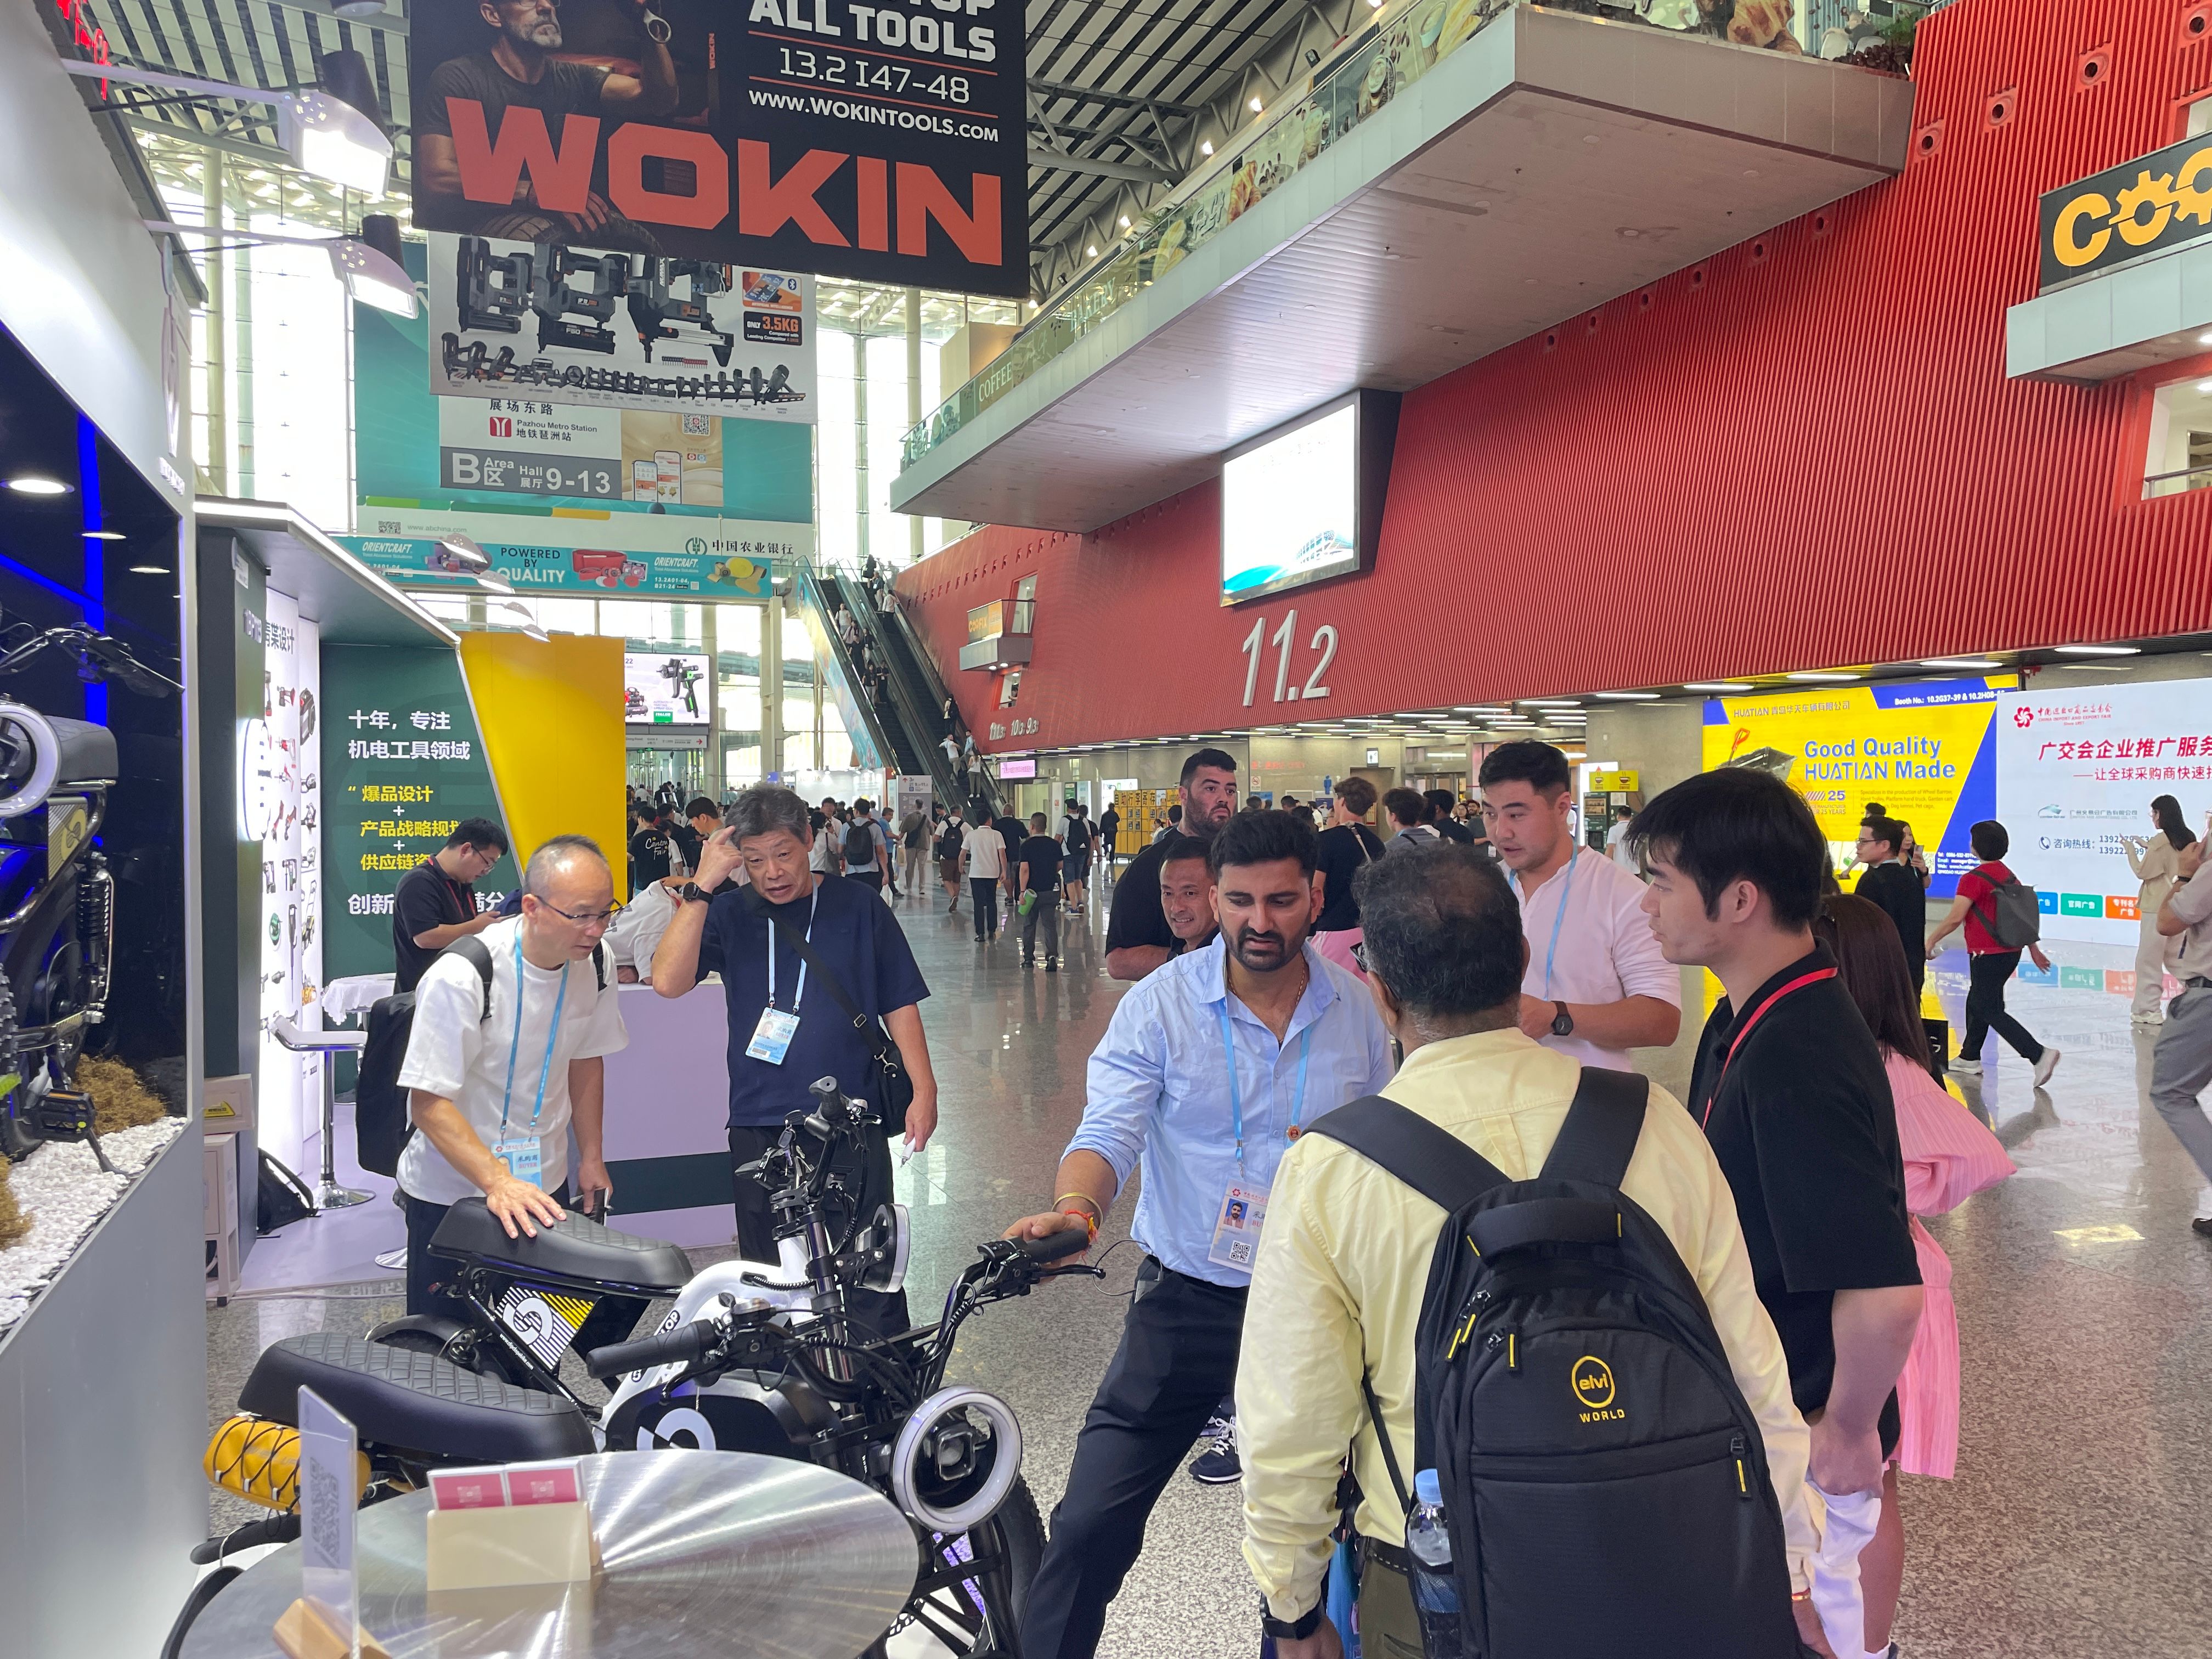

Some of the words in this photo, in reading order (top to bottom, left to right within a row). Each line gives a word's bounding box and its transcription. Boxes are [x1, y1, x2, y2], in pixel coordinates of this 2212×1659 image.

[748, 0, 840, 36] ALL
[849, 4, 996, 62] TOOLS
[780, 48, 846, 84] 13.2
[855, 60, 969, 104] I47-48
[445, 97, 1002, 266] WOKIN
[763, 316, 799, 332] 3.5KG
[979, 362, 1012, 402] COFFEE
[490, 398, 553, 415] 展场东路
[517, 420, 546, 428] Pazhou
[571, 424, 597, 432] Station
[516, 428, 572, 442] 地铁琶洲站
[453, 453, 481, 484] B
[484, 457, 514, 469] Area
[484, 467, 504, 487] 区
[520, 466, 543, 477] Hall
[520, 477, 543, 489] 展厅
[546, 468, 611, 494] 9-13
[408, 524, 467, 533] www.abchina.com
[362, 541, 413, 554] ORIENTCRAFT
[501, 548, 560, 559] POWERED
[712, 539, 793, 555] 中国农业银行
[524, 558, 537, 568] BY
[654, 557, 698, 568] ORIENTCRAFT
[497, 567, 566, 583] QUALITY
[1242, 610, 1339, 708] 11.2
[1895, 697, 1912, 706] Booth
[1927, 694, 1961, 703] 10.2G37-39
[1962, 693, 1968, 701] &
[1734, 707, 1769, 718] HUATIAN
[1771, 701, 1850, 715] 青岛华天车辆有限公司
[348, 741, 471, 760] 机电工具领域
[1804, 739, 1856, 758] Good
[1863, 736, 1942, 759] Quality
[2039, 736, 2212, 761] 广交会企业推广服务
[1805, 761, 1888, 781] HUATIAN
[1895, 760, 1956, 780] Made
[1827, 790, 1846, 801] 25
[348, 894, 394, 915] 创新
[1579, 1373, 1609, 1390] elvi
[1579, 1408, 1625, 1423] WORLD
